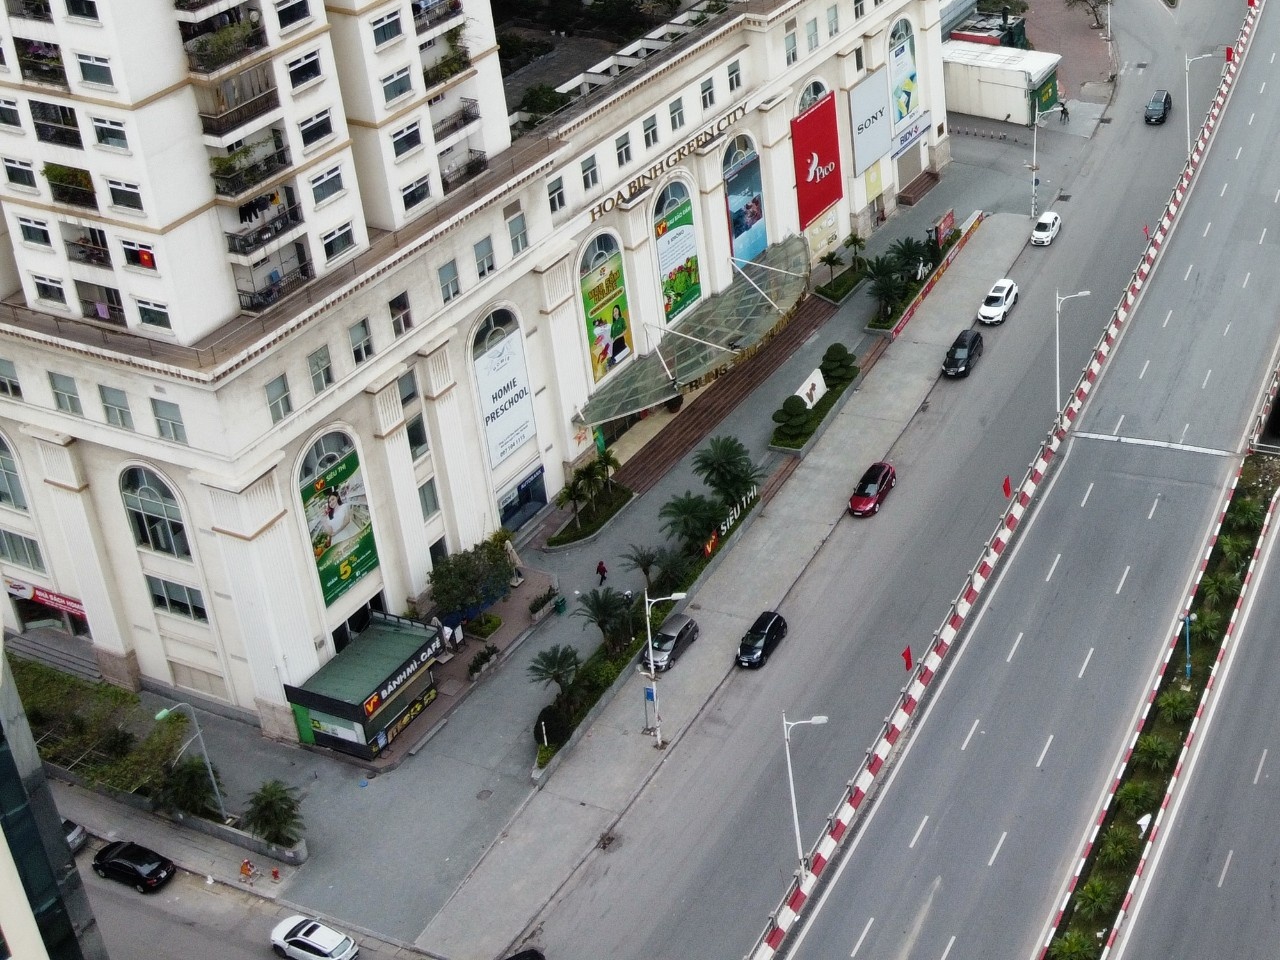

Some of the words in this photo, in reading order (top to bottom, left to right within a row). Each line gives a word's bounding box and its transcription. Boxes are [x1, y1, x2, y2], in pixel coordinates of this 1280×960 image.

[857, 106, 885, 135] SONY
[900, 127, 913, 145] BIDV
[590, 190, 626, 223] HOA
[627, 163, 665, 197] BINH
[666, 125, 715, 168] GREEN
[716, 102, 748, 133] CITY
[491, 377, 517, 404] HOMIE
[485, 387, 529, 426] PRESCHOOL
[720, 503, 741, 536] SIÊU
